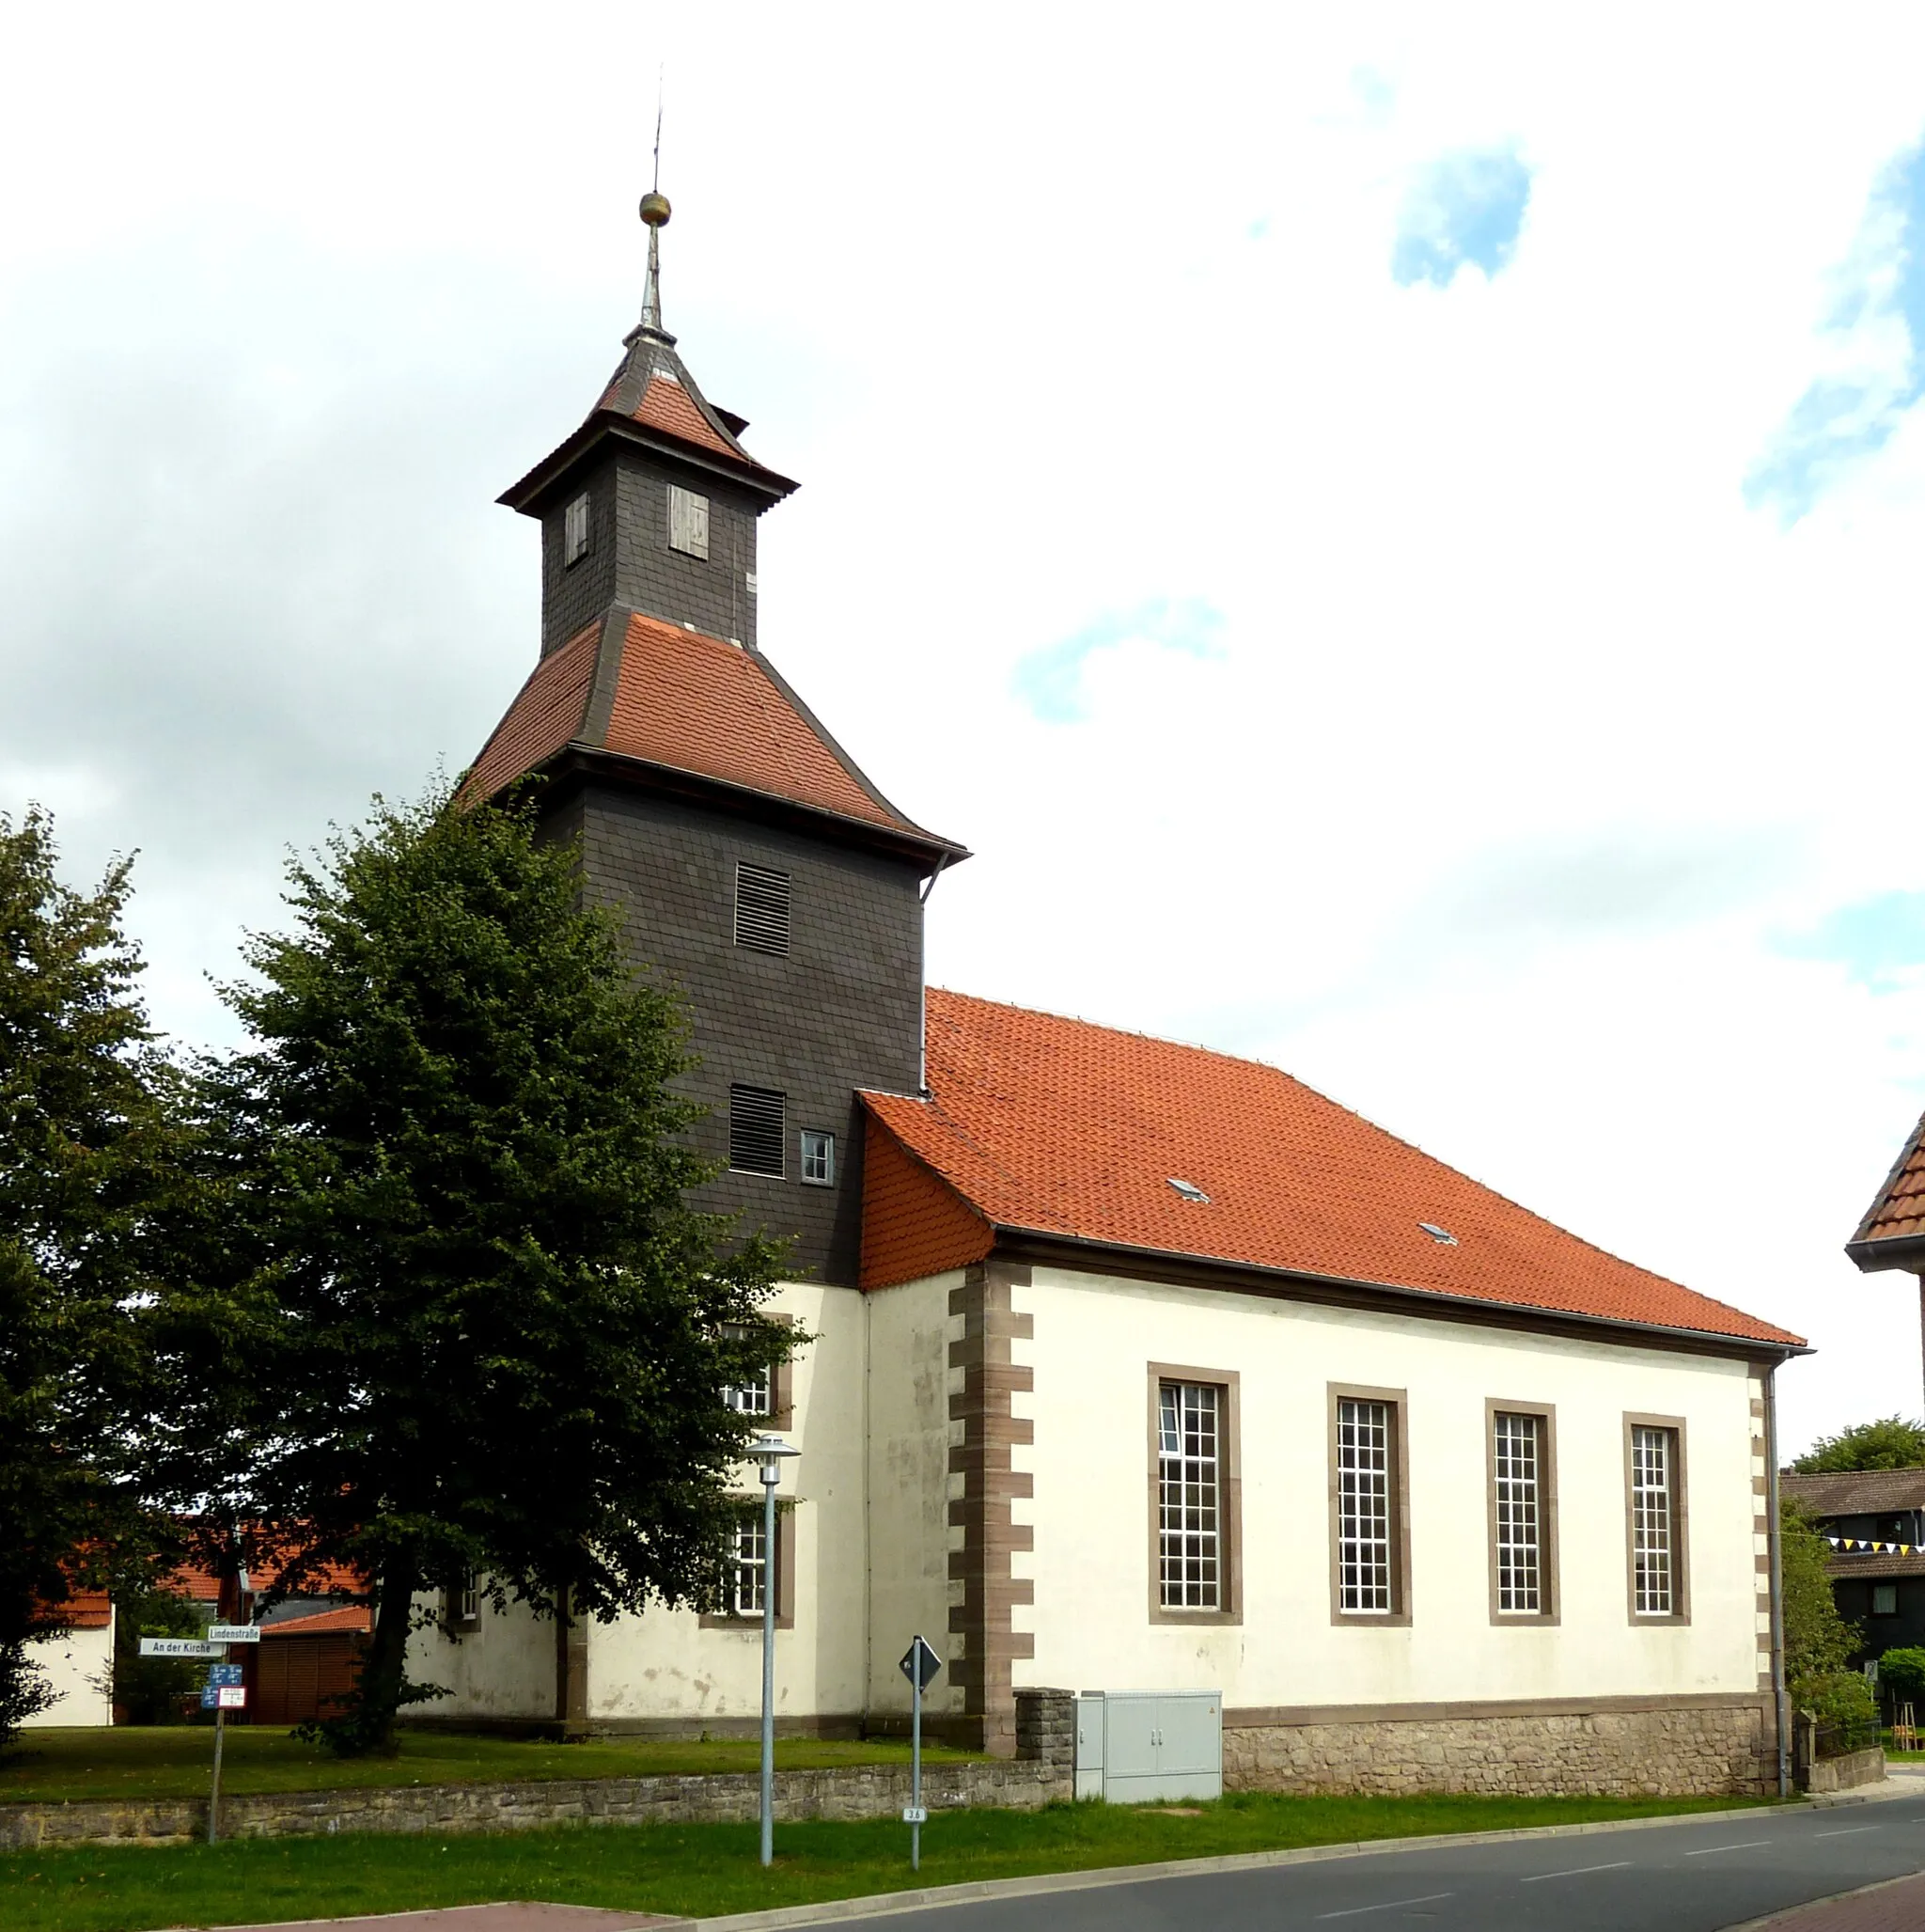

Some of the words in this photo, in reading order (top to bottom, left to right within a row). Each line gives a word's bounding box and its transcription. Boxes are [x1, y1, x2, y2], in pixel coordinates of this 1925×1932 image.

[210, 1628, 258, 1639] Lindenstraße
[153, 1642, 164, 1652] An
[166, 1642, 180, 1652] der
[184, 1643, 211, 1653] Kirche
